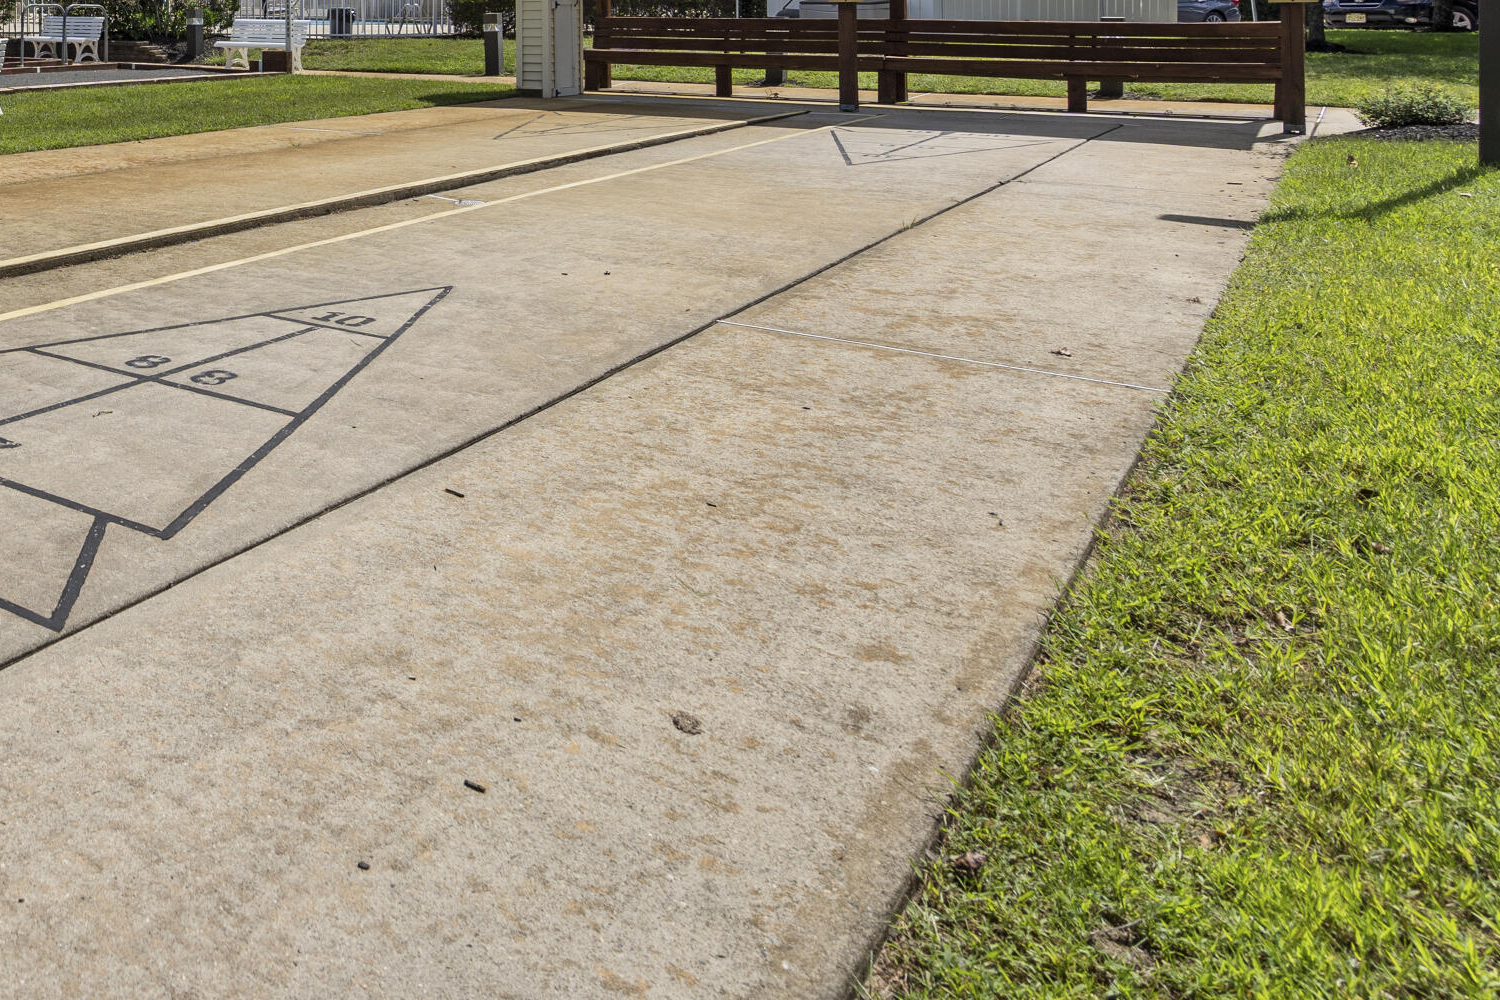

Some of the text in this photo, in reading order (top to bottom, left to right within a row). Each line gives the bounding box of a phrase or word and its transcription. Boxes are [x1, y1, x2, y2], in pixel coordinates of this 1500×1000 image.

[311, 311, 376, 328] 10
[124, 354, 238, 386] 8 8
